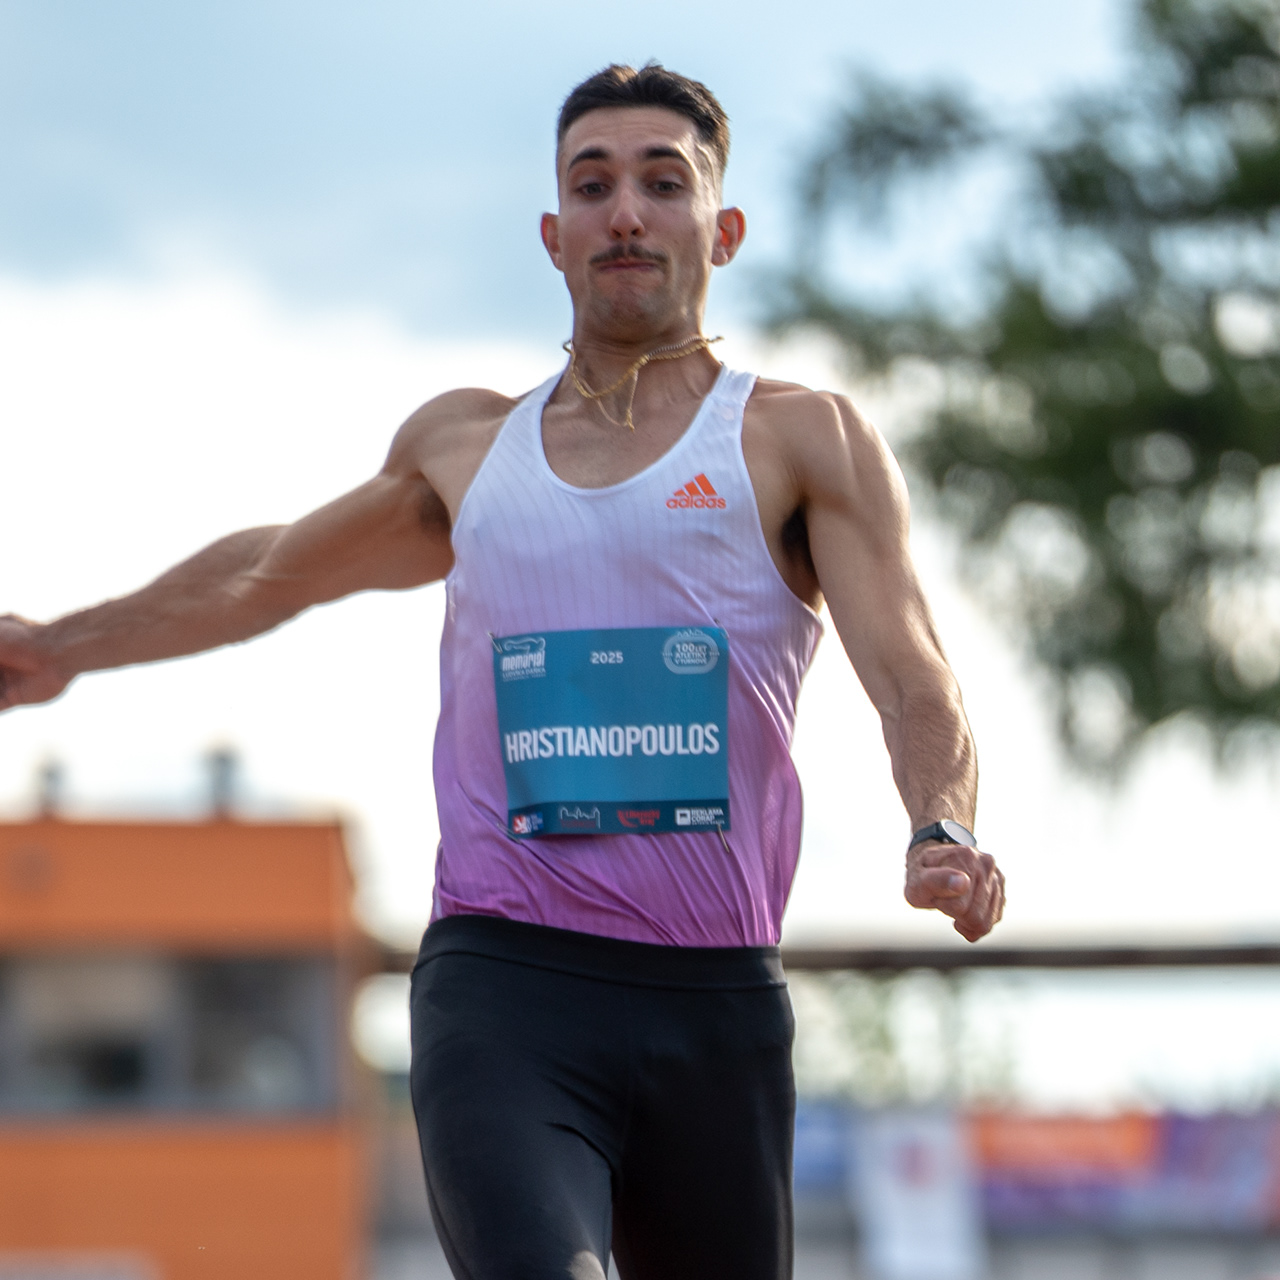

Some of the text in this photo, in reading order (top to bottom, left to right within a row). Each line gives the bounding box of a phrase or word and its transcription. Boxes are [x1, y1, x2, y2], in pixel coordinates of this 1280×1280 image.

[665, 495, 727, 510] adidas
[589, 651, 624, 665] 2025
[504, 723, 720, 764] HRISTIANOPOULOS
